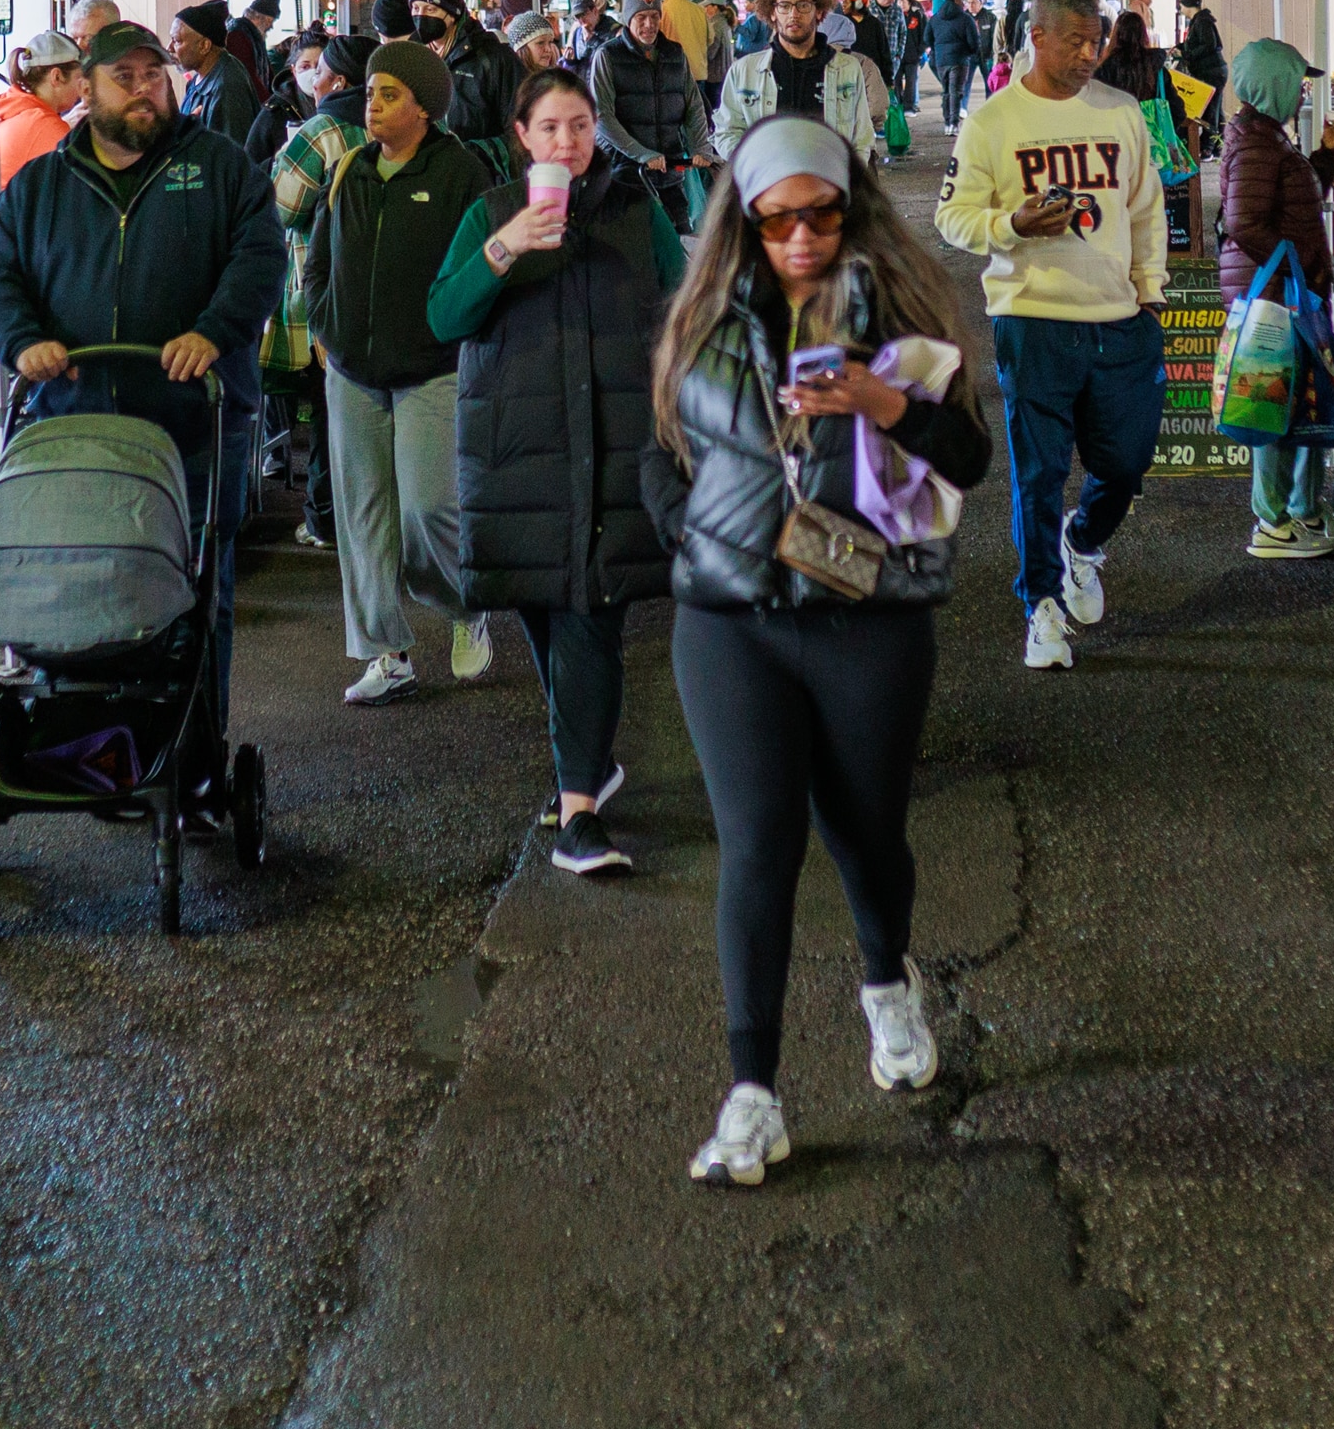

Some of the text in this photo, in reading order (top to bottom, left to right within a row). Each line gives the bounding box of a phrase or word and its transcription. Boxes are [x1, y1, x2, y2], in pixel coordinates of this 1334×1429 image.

[1014, 143, 1121, 195] POLY
[940, 182, 955, 202] 3
[1192, 295, 1223, 303] MIXER
[1161, 310, 1227, 328] UTHSID
[1207, 456, 1223, 464] FOR
